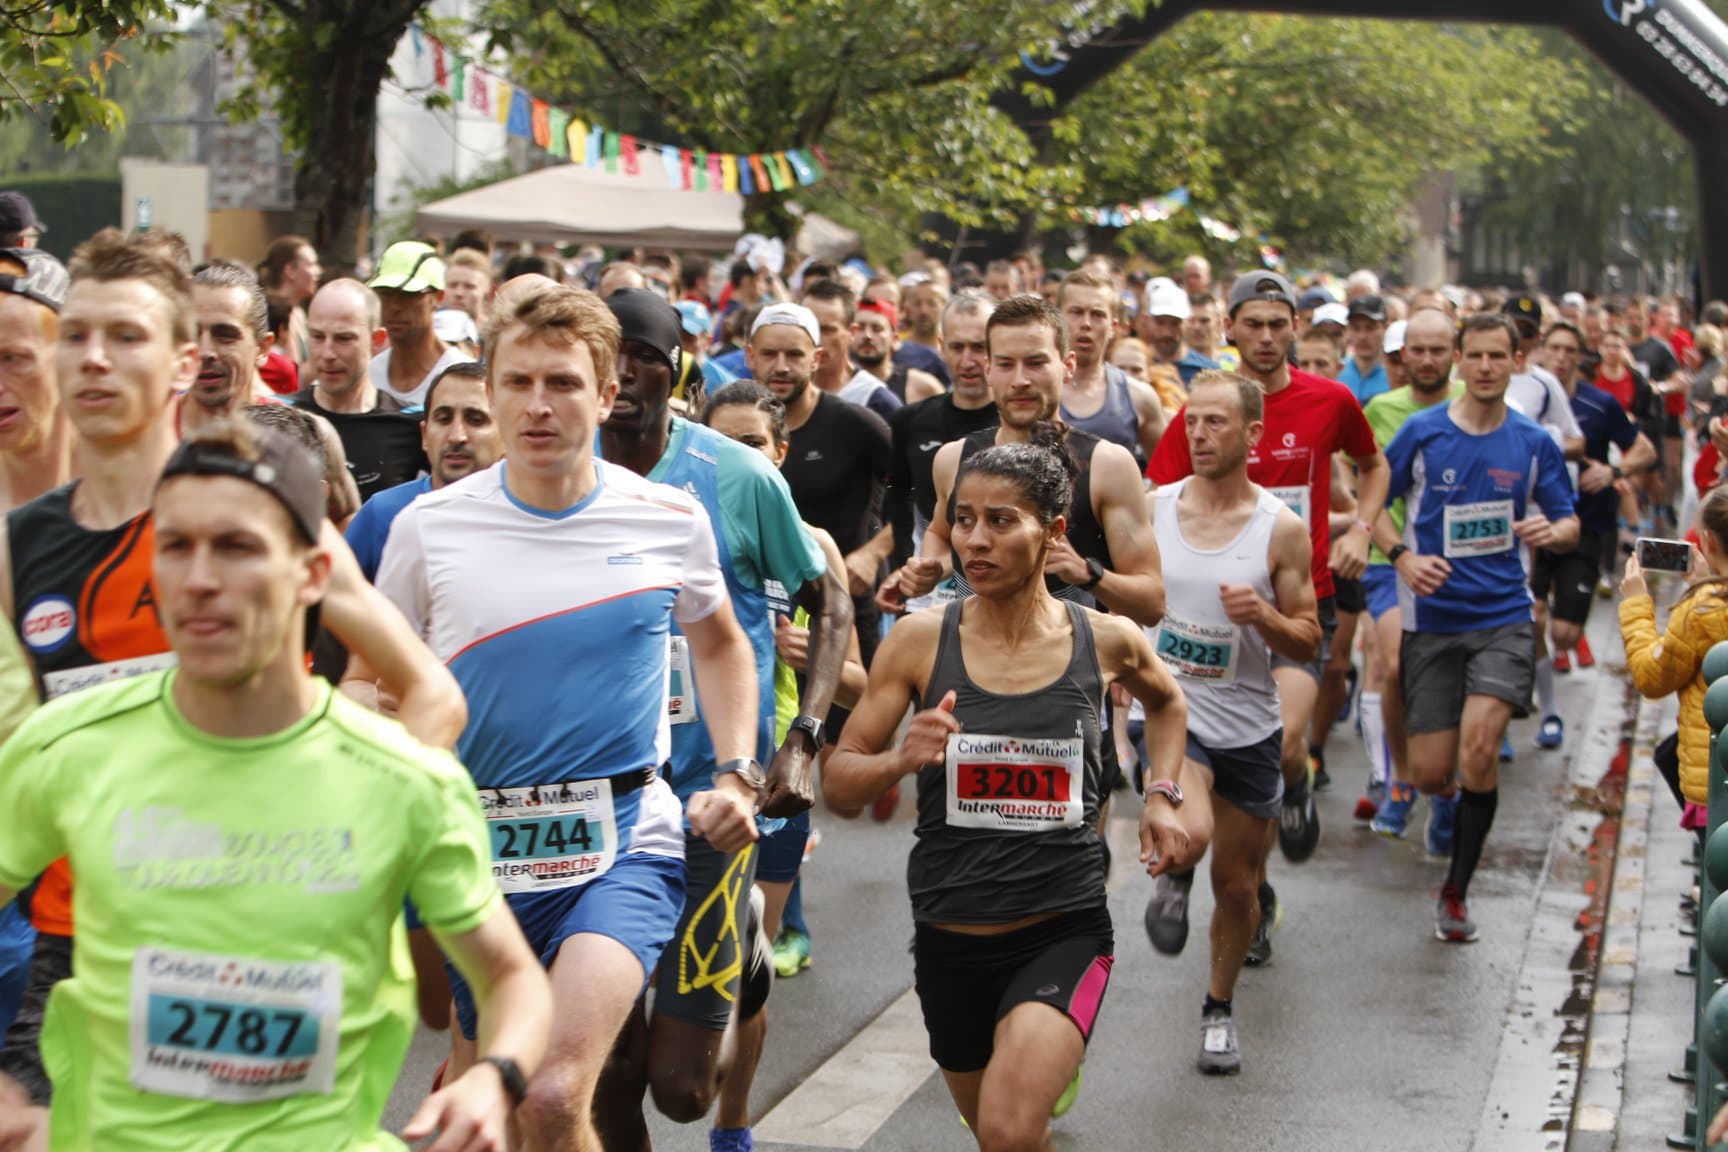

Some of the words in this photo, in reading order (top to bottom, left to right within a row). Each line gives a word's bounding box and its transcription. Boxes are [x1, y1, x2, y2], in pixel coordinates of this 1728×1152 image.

[1456, 519, 1503, 539] 2753
[24, 610, 71, 637] cora
[1165, 633, 1223, 666] 2923
[958, 740, 1002, 754] Crédit
[1022, 743, 1072, 758] Mutuel
[971, 766, 1057, 800] 3201
[497, 818, 592, 858] 2744
[166, 1000, 305, 1057] 2787
